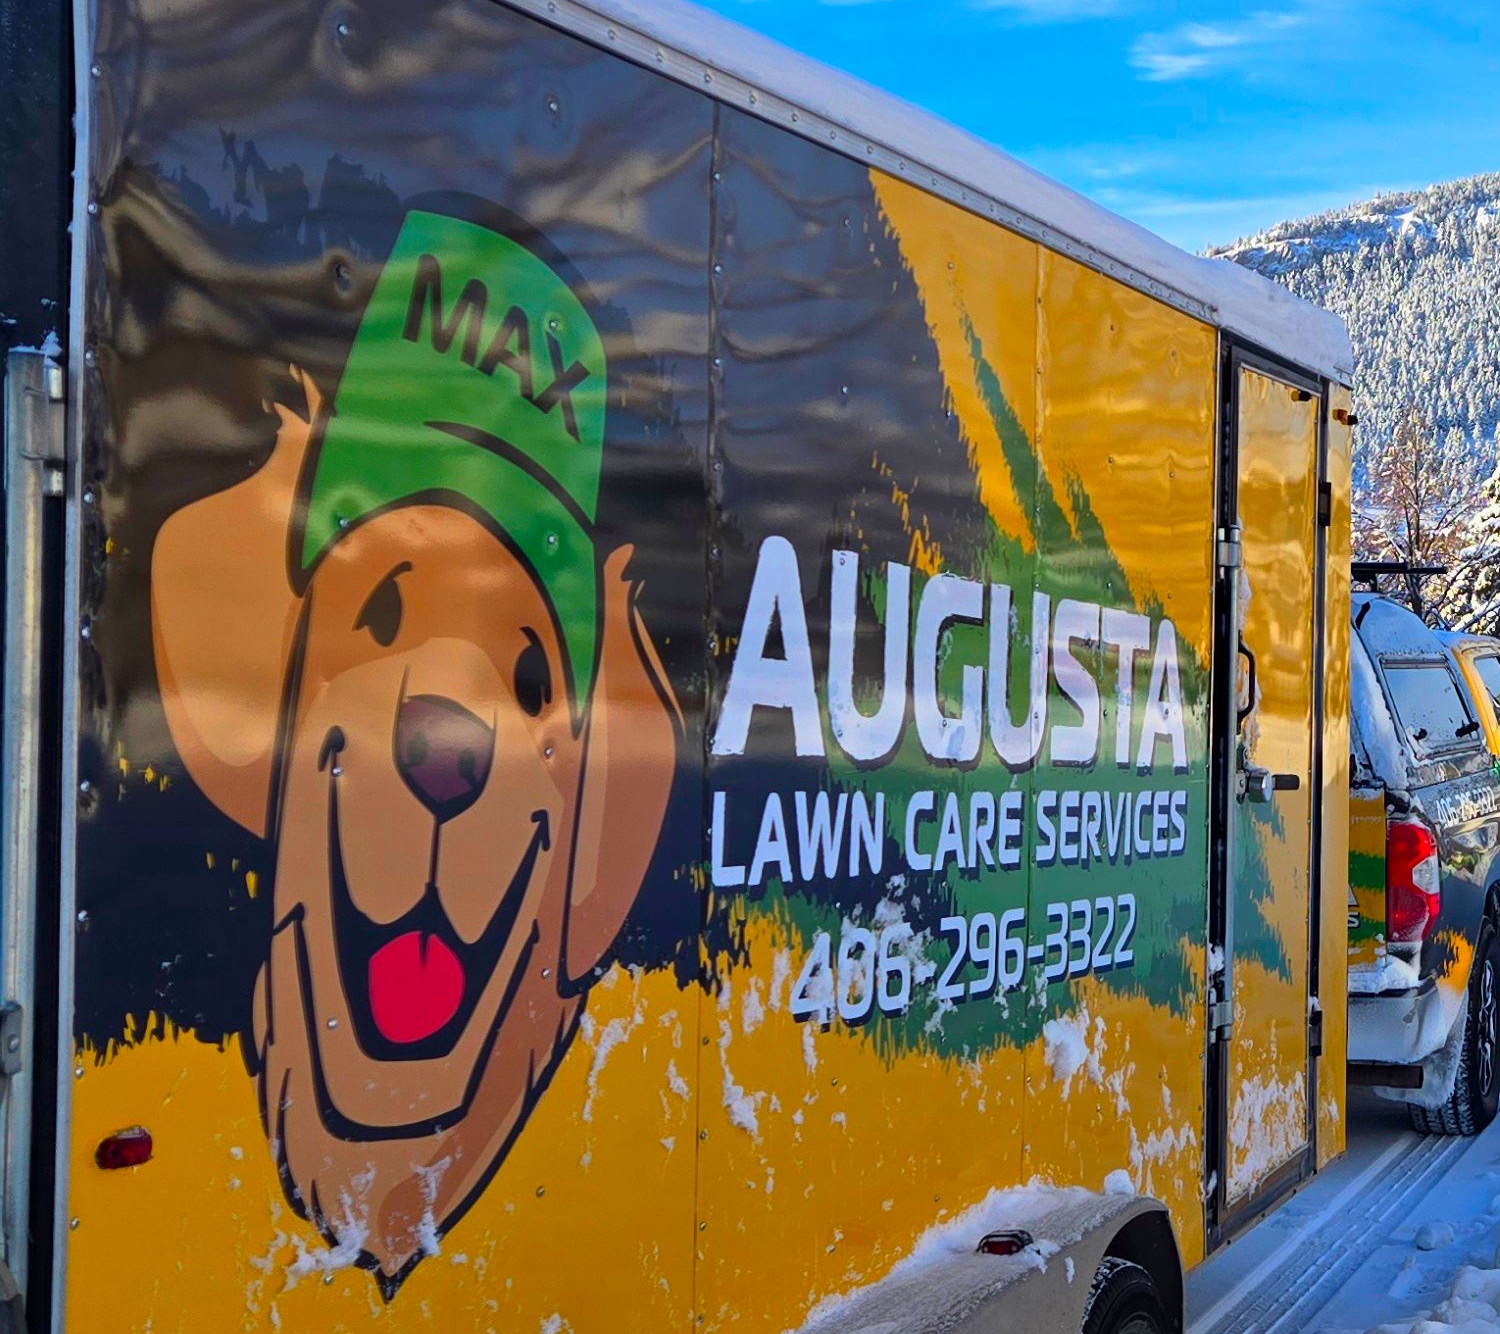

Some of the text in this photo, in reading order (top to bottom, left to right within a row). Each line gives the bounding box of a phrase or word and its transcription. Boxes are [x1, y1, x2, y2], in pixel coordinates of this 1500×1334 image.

[402, 253, 591, 444] MAX
[711, 535, 1189, 771] AUGUSTA
[711, 790, 1188, 887] LAWN CARE SERVICES
